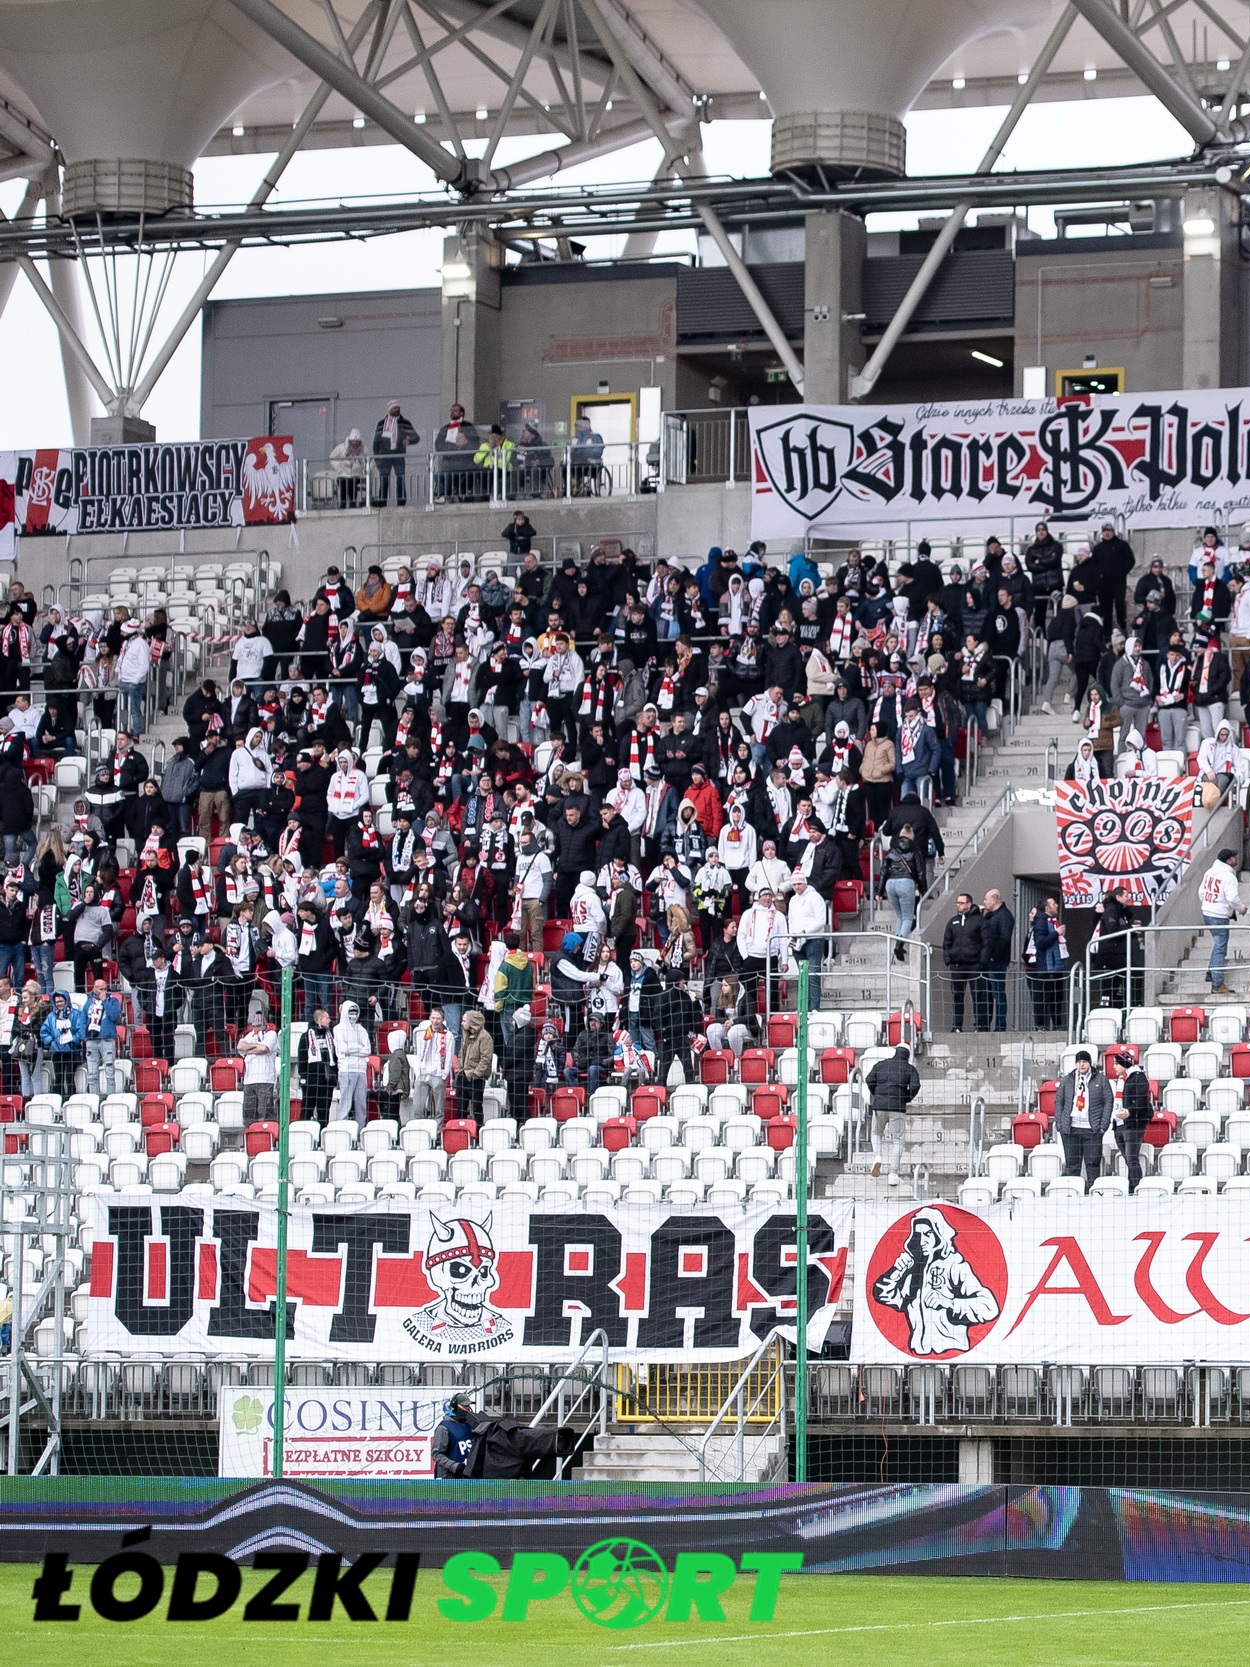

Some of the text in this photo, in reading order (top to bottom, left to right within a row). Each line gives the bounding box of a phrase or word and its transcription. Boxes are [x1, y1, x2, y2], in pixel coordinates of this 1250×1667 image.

[953, 403, 993, 424] innych
[996, 400, 1036, 416] trzeba
[74, 441, 249, 505] PIOTRKOWSCY
[841, 415, 1029, 505] Stare
[78, 495, 234, 530] EŁKAESIACY
[1122, 492, 1152, 520] tylko
[1156, 490, 1188, 511] kilku
[1195, 499, 1216, 510] nas
[1072, 818, 1176, 849] 1908
[861, 989, 872, 1000] 13
[986, 1057, 996, 1068] 11
[108, 1205, 835, 1350] ULTRAS
[402, 1317, 515, 1355] GALERA WARRIORS
[365, 1449, 425, 1464] SZKOŁY
